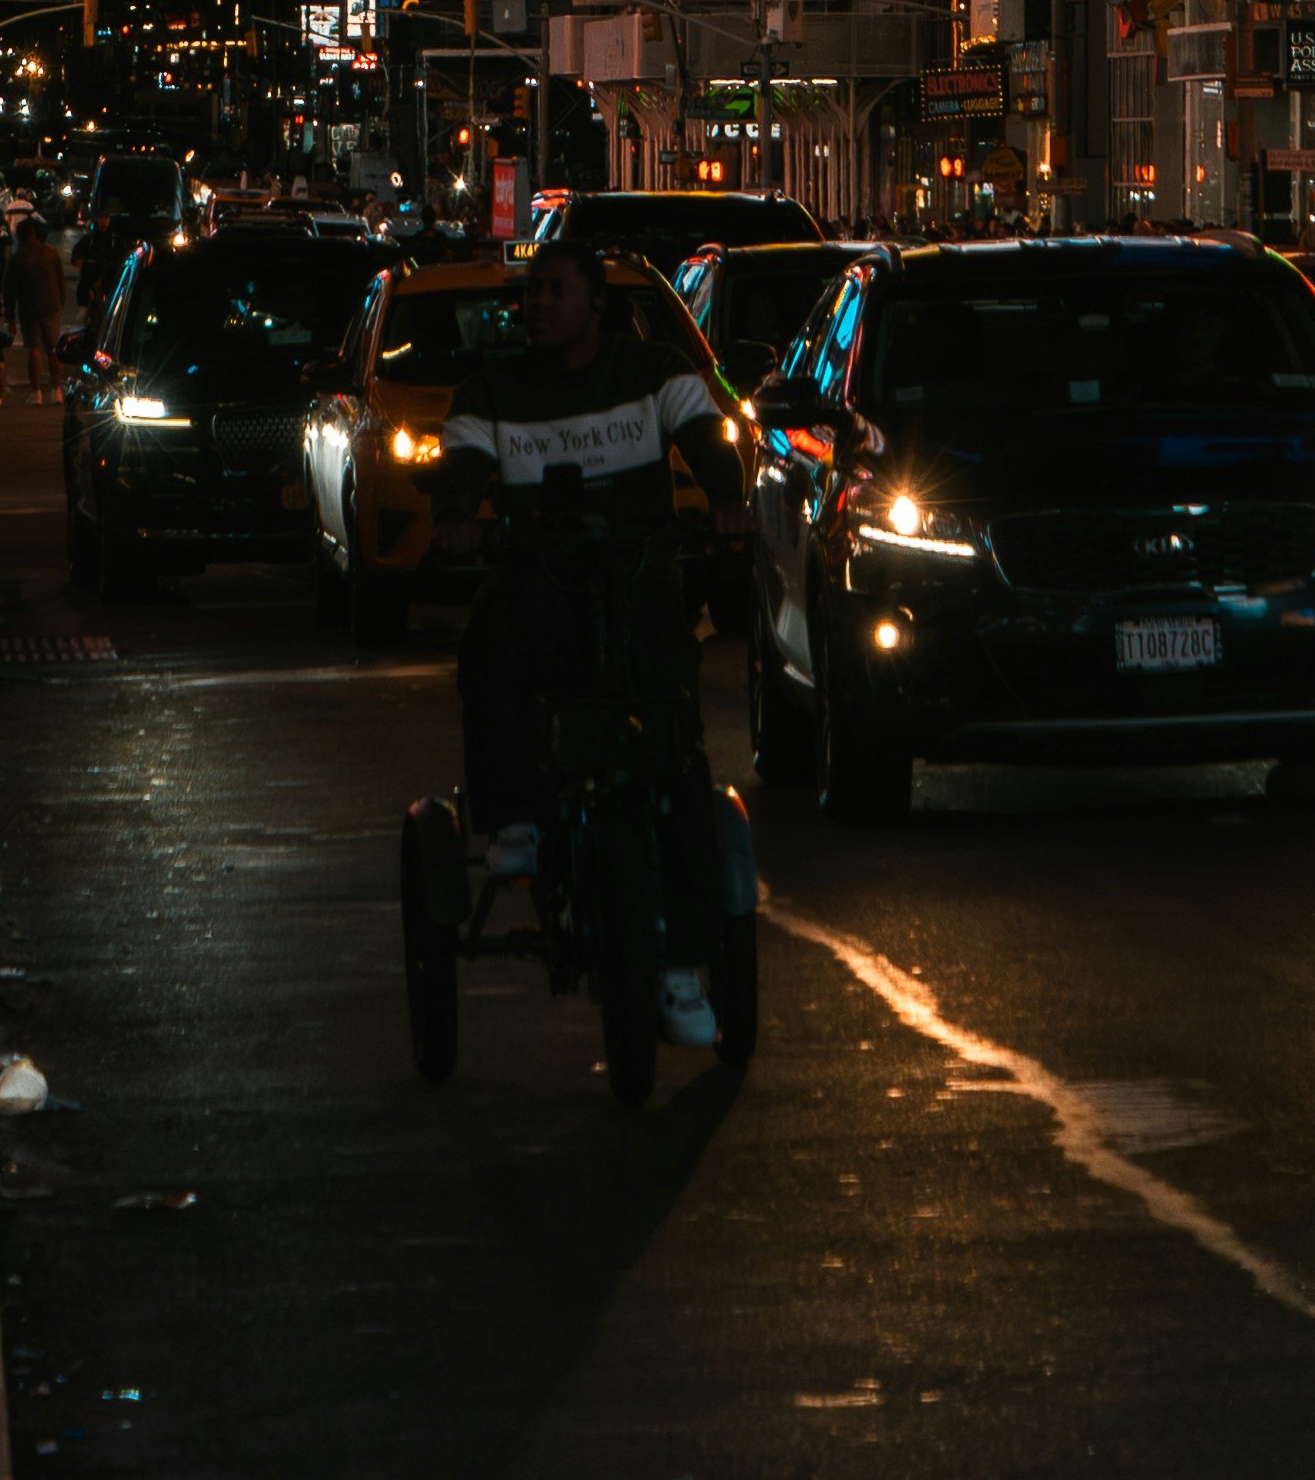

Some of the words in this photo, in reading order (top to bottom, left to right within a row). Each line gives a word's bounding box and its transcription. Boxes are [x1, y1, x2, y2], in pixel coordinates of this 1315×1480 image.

[927, 73, 998, 96] ELECTRONICS
[927, 100, 961, 114] CAMERA
[963, 97, 1001, 112] LUGGAGE
[509, 435, 550, 456] New
[559, 426, 603, 453] York
[607, 418, 645, 445] City
